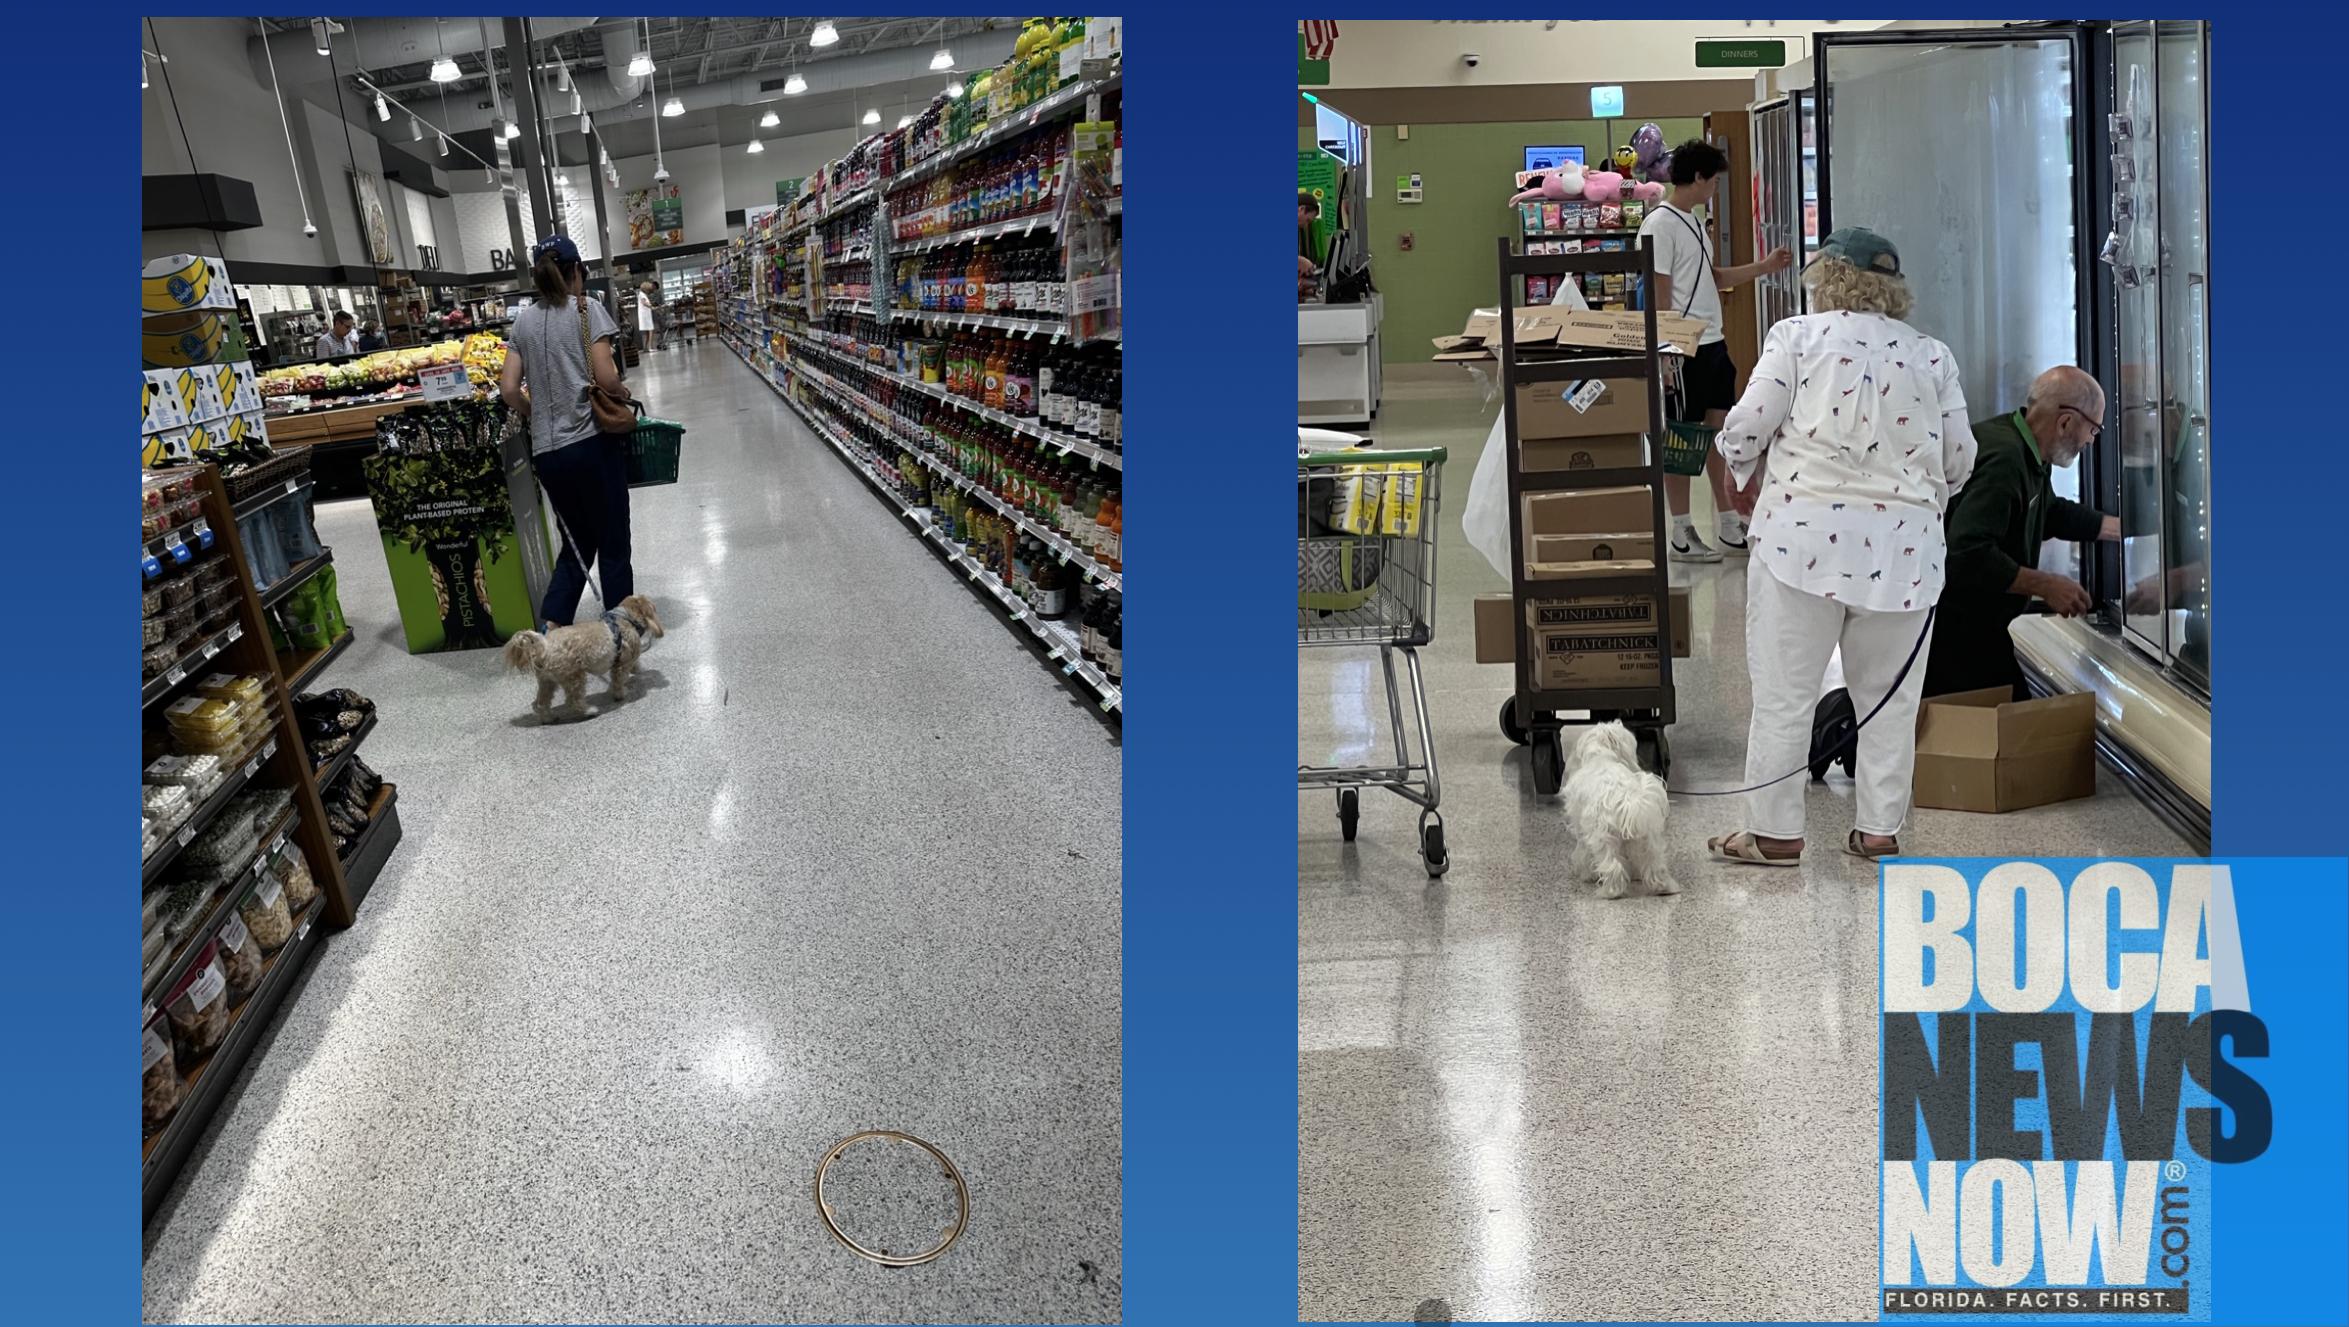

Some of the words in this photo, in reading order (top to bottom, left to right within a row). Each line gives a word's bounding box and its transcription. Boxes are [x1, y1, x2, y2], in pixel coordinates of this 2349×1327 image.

[1721, 50, 1759, 58] DINNERS
[1603, 92, 1612, 106] 5
[788, 180, 795, 189] 2
[416, 503, 431, 511] THE
[432, 500, 468, 510] ORIGINAL
[403, 510, 452, 520] PLANT-BASED
[453, 506, 485, 516] PROTEIN
[436, 540, 469, 551] Wonderful
[448, 553, 475, 627] PISTACHIOS
[1551, 636, 1655, 650] TABATCHNICK
